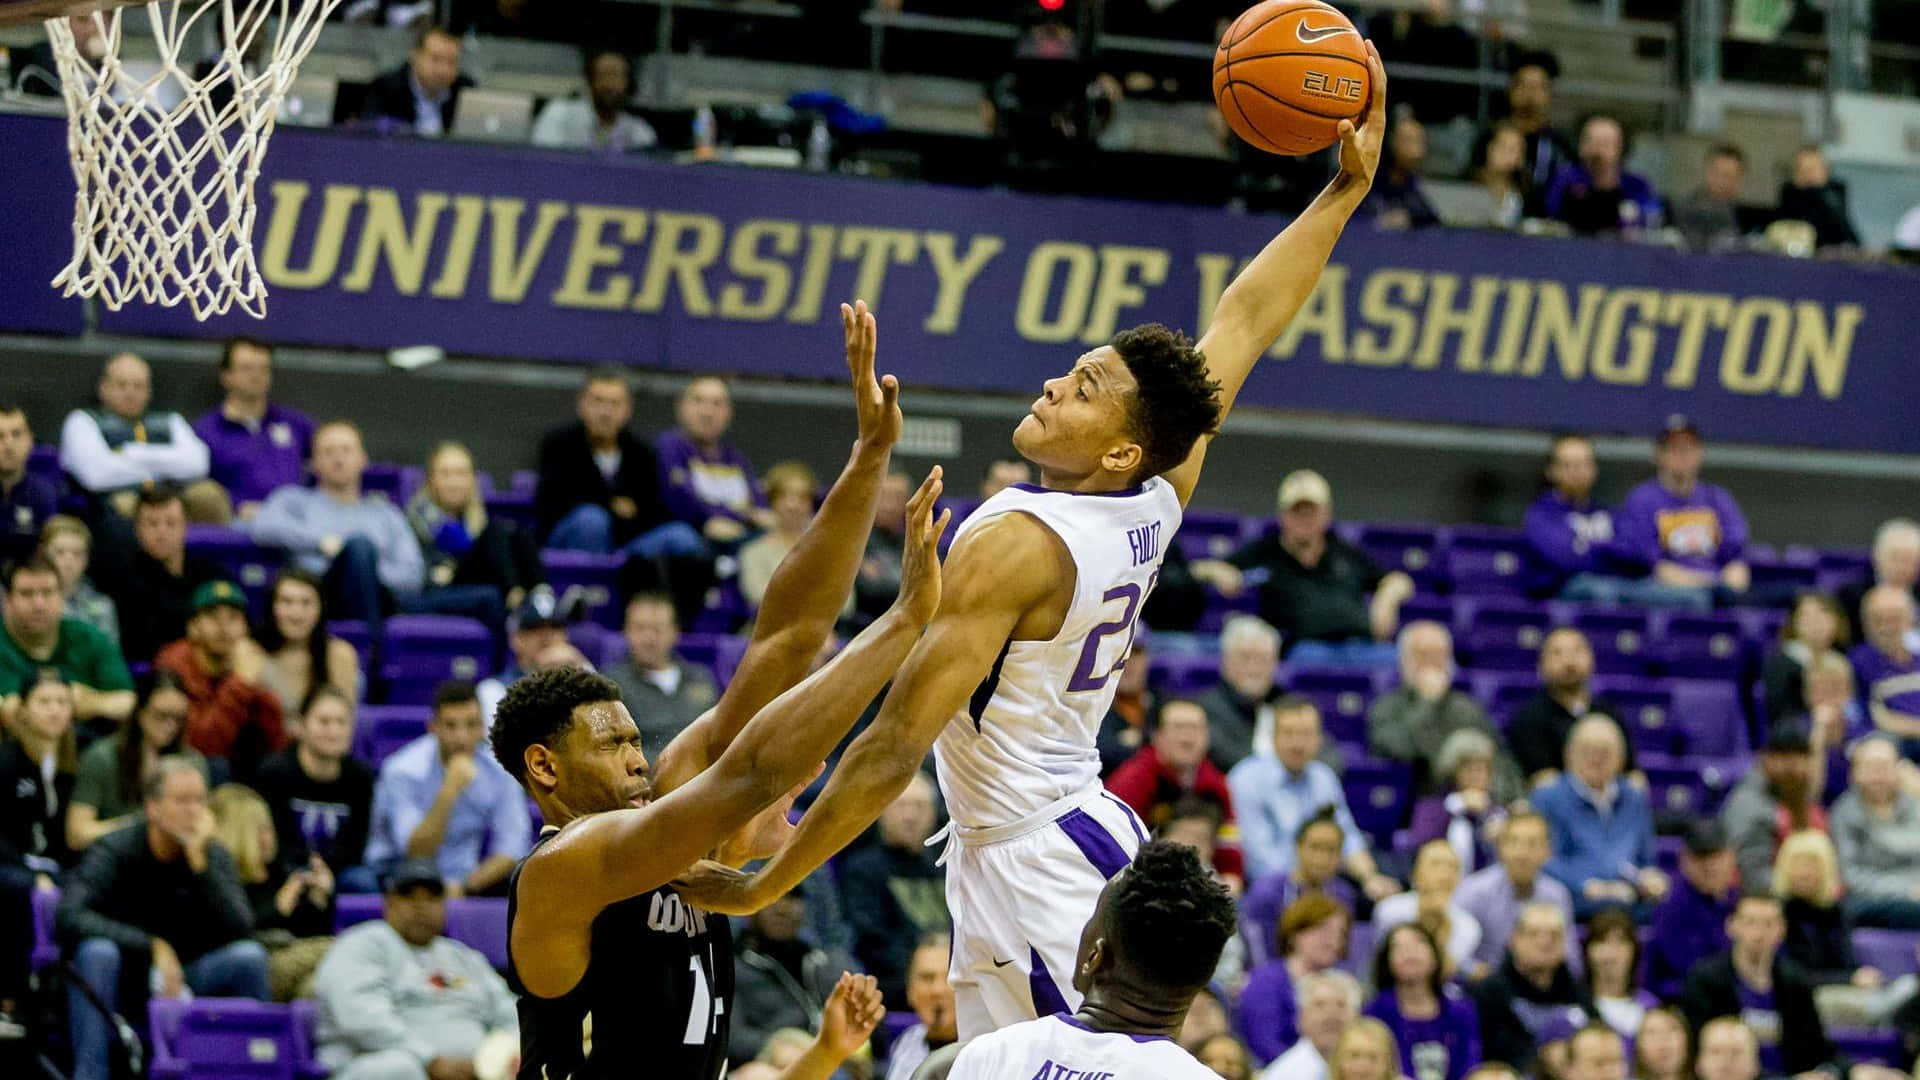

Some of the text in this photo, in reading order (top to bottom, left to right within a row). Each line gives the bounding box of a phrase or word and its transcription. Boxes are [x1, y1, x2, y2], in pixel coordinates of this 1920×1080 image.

[1303, 70, 1362, 99] ELITE
[262, 179, 1004, 335] UNIVERSITY
[1015, 241, 1171, 345] OF
